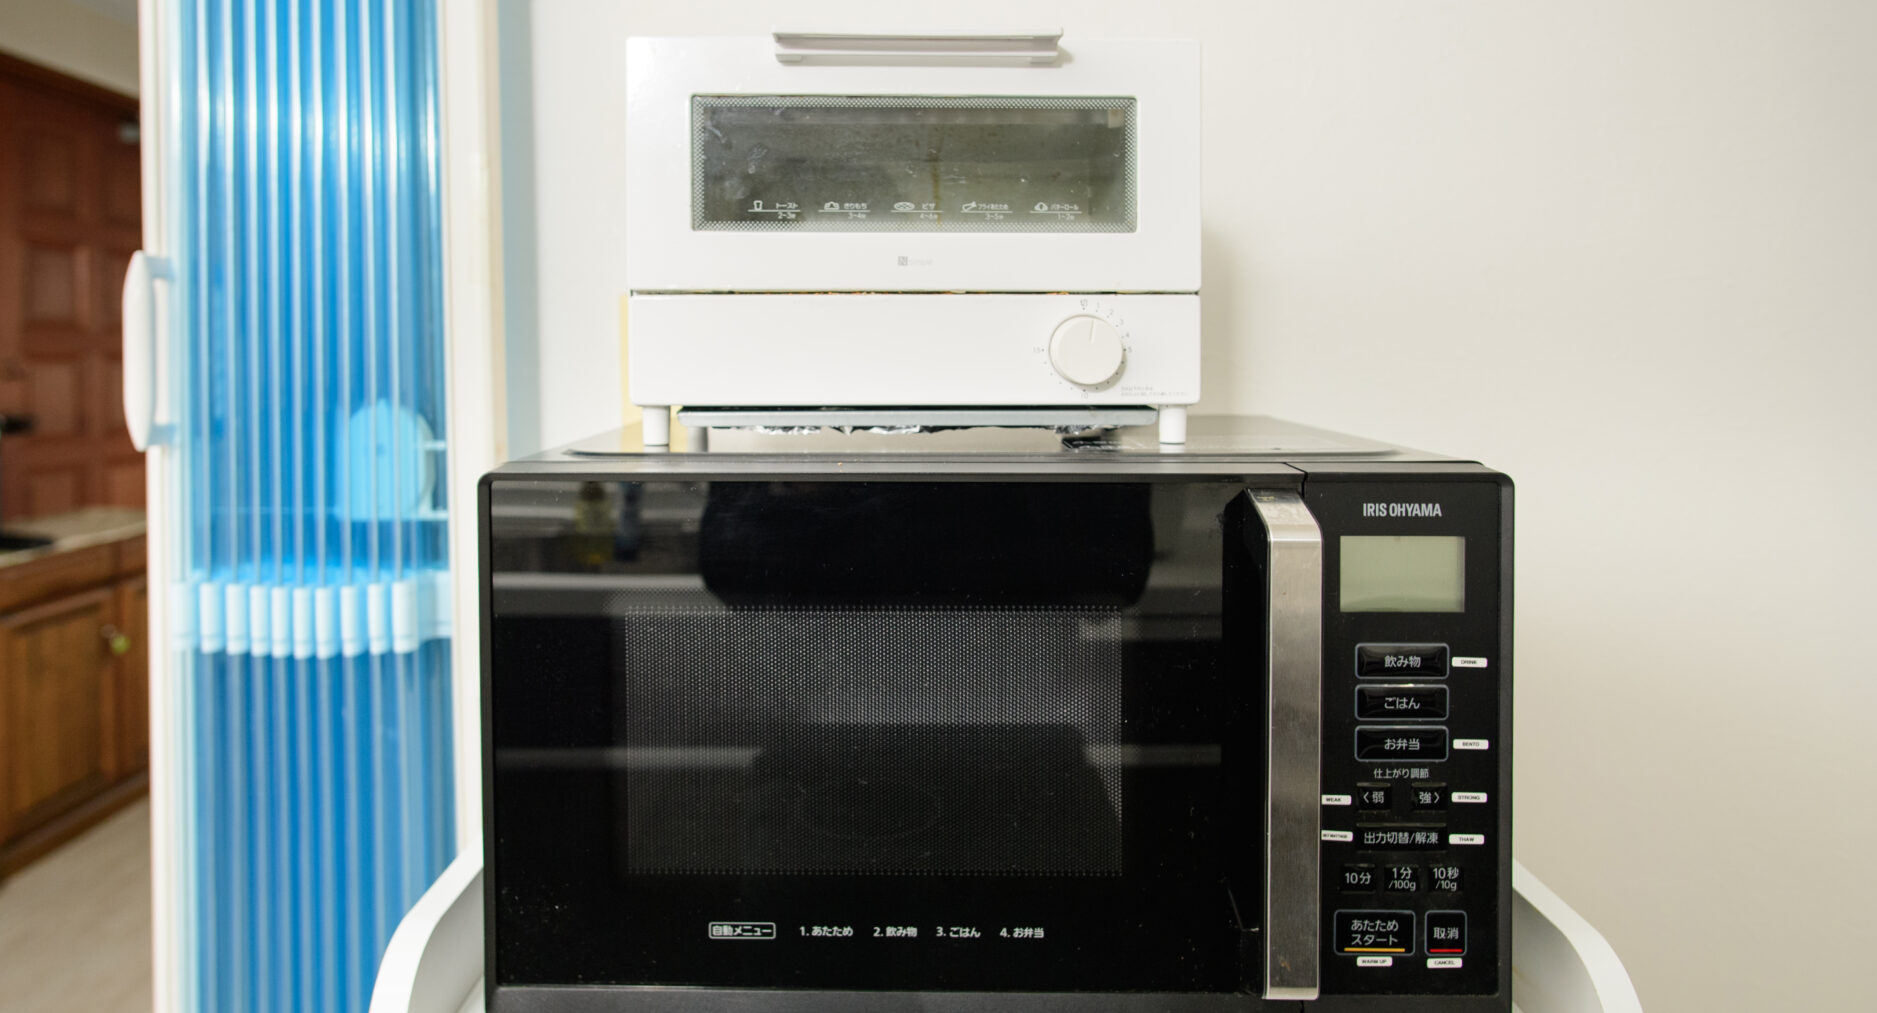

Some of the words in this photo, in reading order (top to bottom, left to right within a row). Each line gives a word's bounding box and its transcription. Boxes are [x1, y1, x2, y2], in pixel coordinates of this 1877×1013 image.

[922, 202, 936, 210] ピザ
[1362, 503, 1387, 517] IRIS
[1388, 503, 1442, 517] OHYAMA
[1384, 655, 1421, 668] 飲み物
[1384, 697, 1421, 709] ごはん
[1384, 738, 1420, 751] お弁当
[1373, 768, 1430, 779] 仕上がり調節
[1363, 832, 1439, 845] 出力切替/解凍
[1388, 880, 1417, 892] /100g
[1435, 880, 1457, 892] /10g
[711, 925, 773, 936] 自動メニュー
[1350, 919, 1399, 932] あたため
[1433, 927, 1459, 940] 取消
[1351, 934, 1398, 946] スタート
